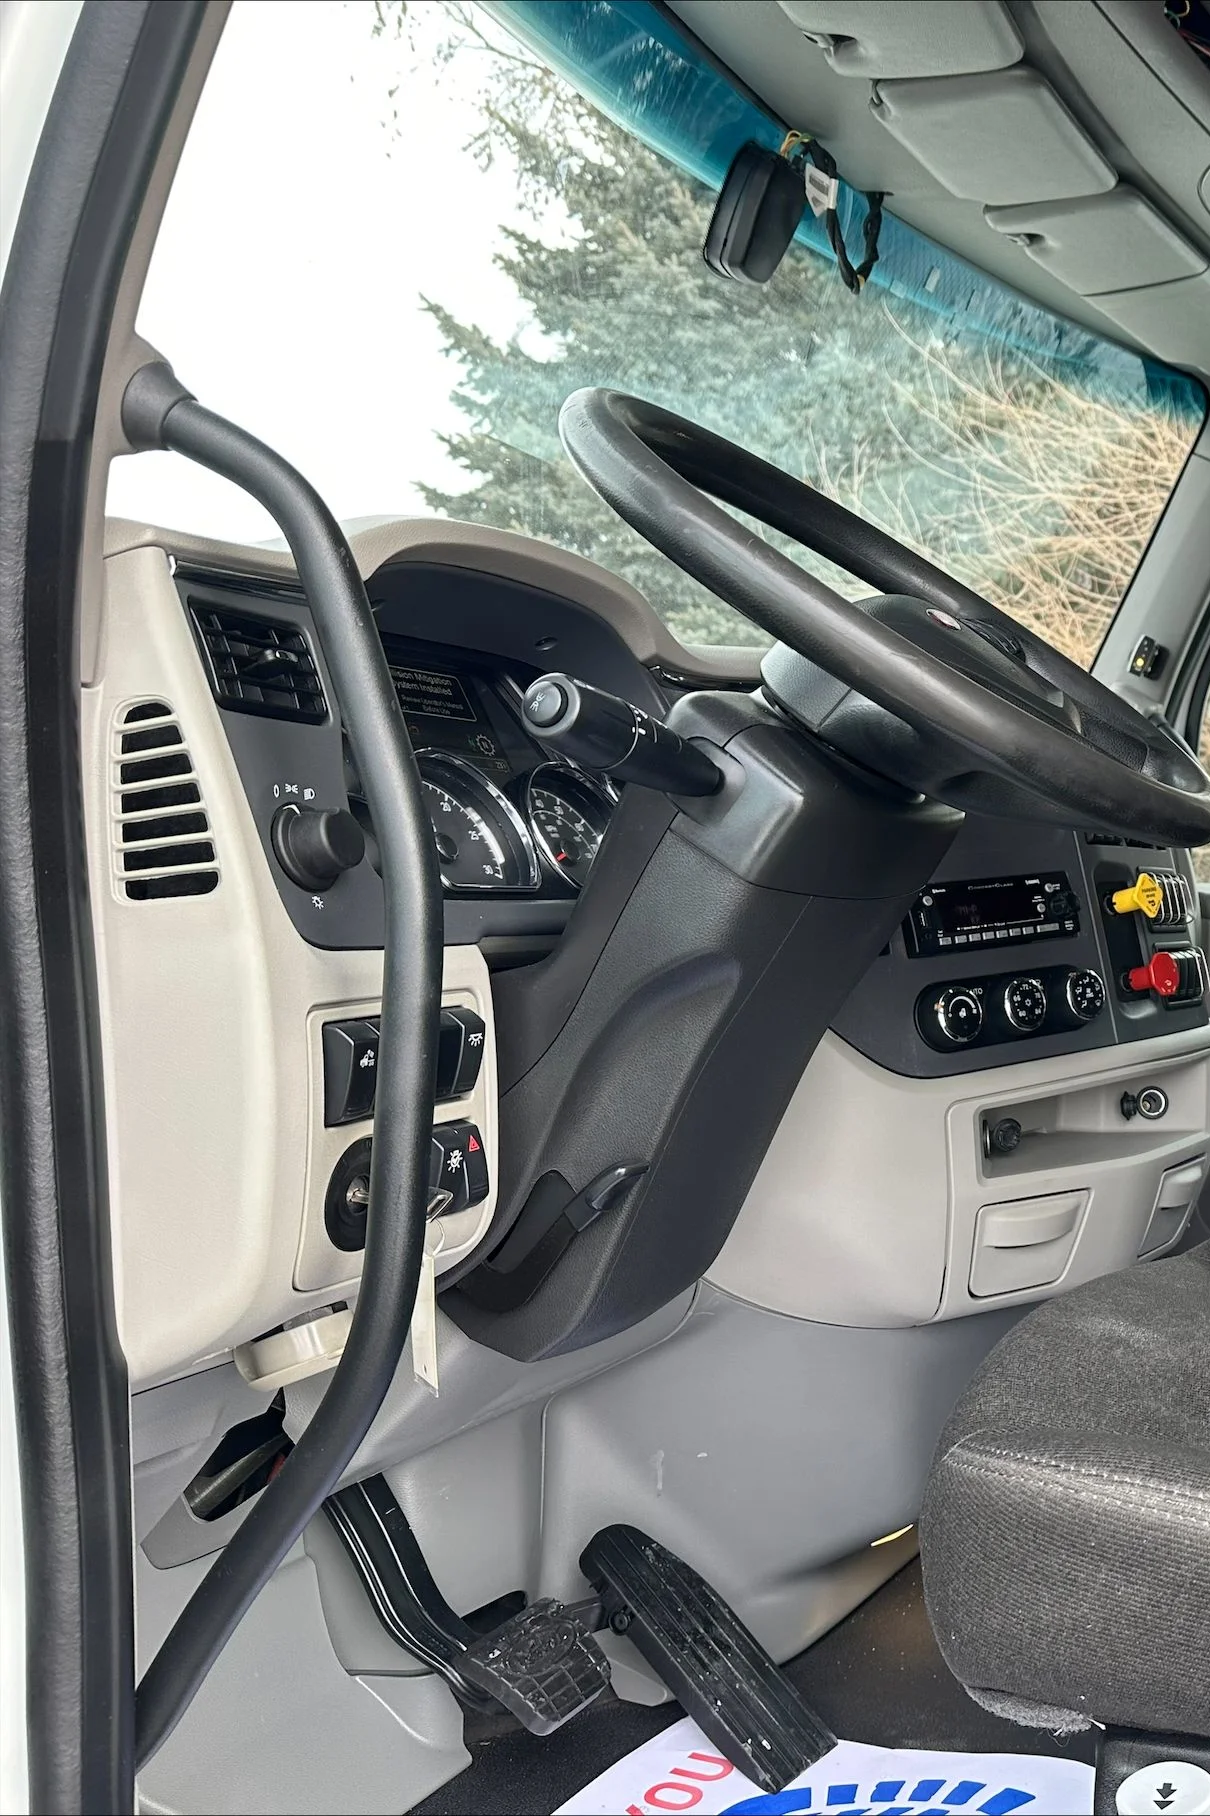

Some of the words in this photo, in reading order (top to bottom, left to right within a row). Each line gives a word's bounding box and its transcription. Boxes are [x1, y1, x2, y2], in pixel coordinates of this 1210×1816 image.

[468, 829, 480, 841] 25
[482, 864, 494, 875] 30
[626, 1752, 734, 1815] OU
